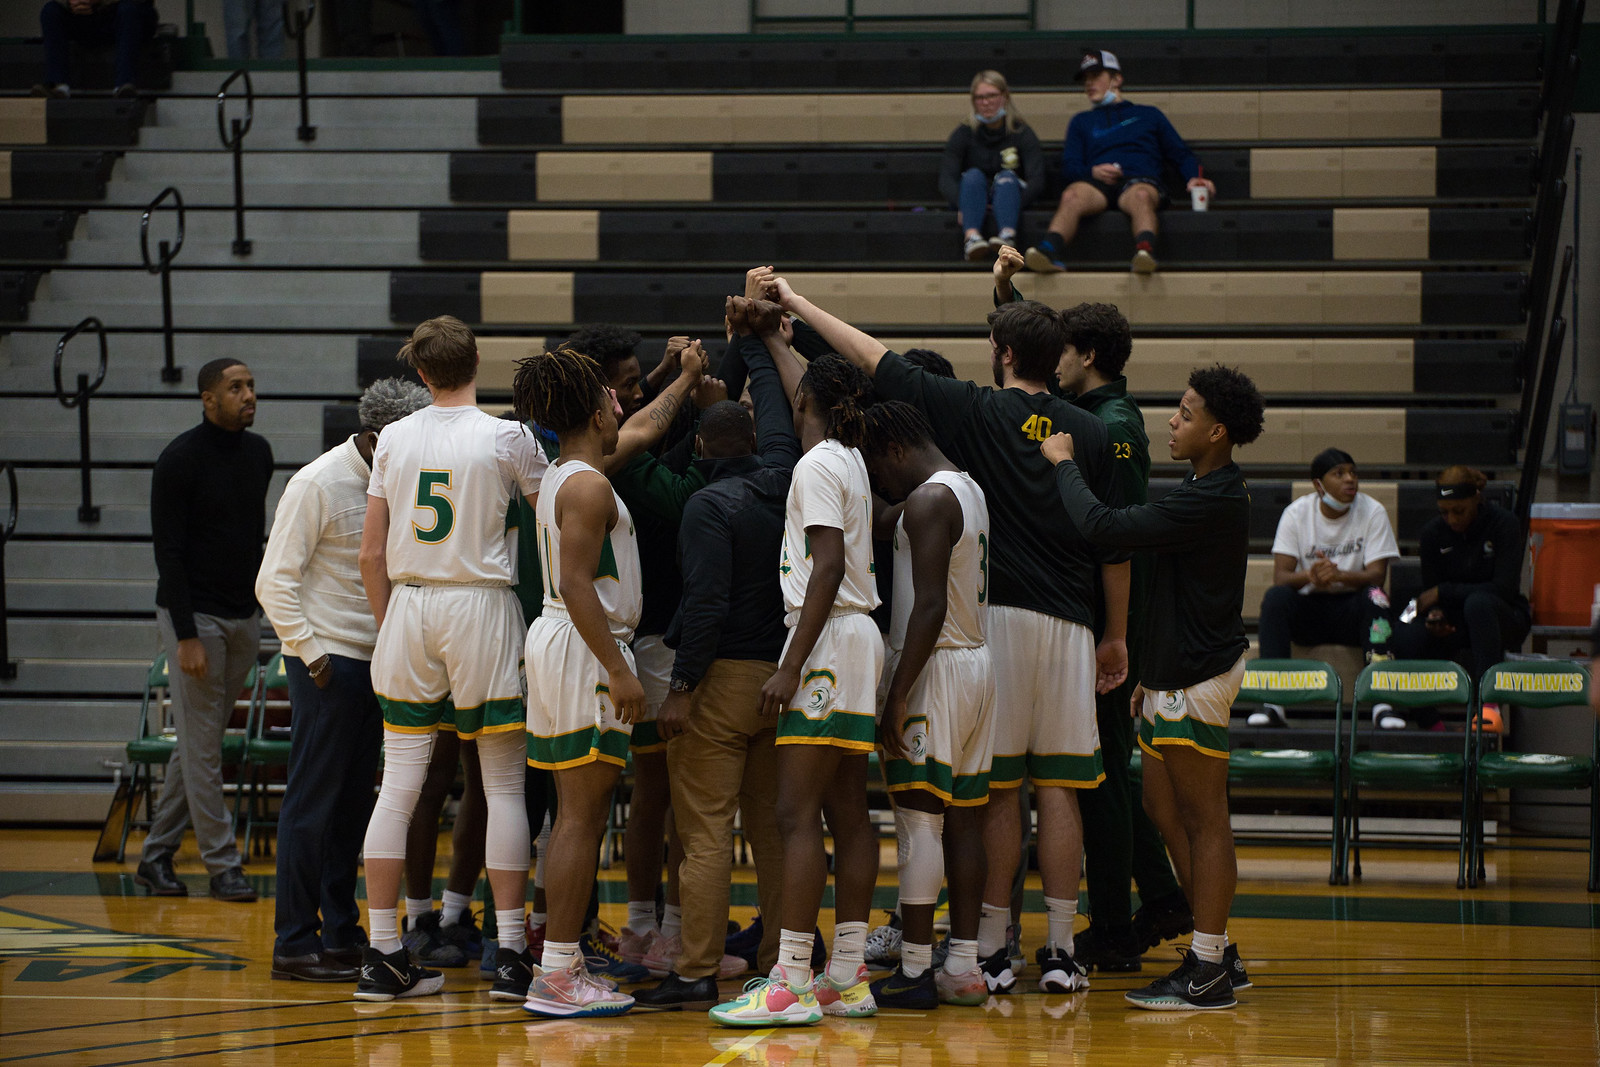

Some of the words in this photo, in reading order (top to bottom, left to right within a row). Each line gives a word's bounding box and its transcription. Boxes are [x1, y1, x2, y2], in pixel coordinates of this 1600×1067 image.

[1021, 414, 1053, 442] 40
[1113, 442, 1133, 459] 23
[411, 468, 456, 545] 5
[1370, 671, 1458, 692] JAYHAWKS
[1493, 671, 1583, 692] JAYHAWKS
